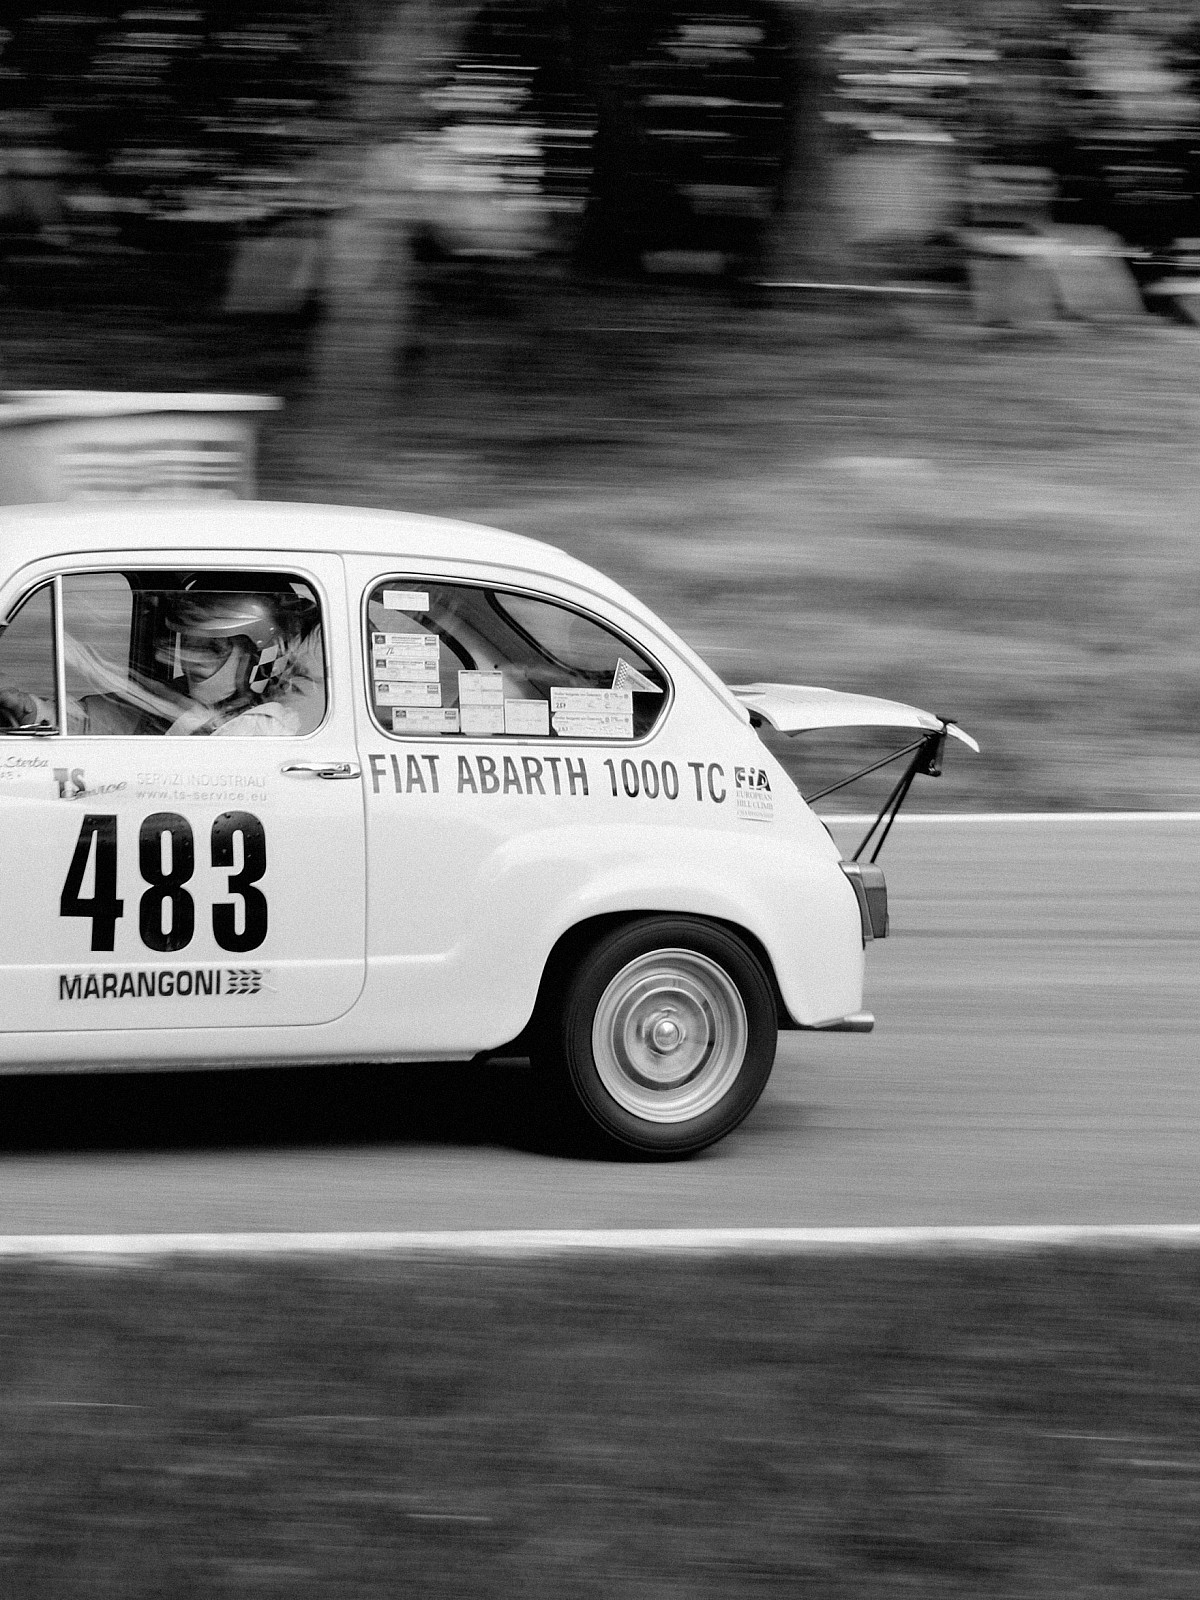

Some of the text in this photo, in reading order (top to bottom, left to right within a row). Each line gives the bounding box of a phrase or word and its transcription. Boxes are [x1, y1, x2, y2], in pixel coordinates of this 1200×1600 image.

[52, 767, 86, 799] TS
[368, 754, 727, 804] FIAT ABARTH 1000 TC
[134, 789, 268, 802] www.ts-service.eu
[736, 790, 773, 801] EUROPEAN
[736, 799, 774, 811] HILL CLIMB
[60, 810, 268, 953] 483
[59, 969, 221, 1001] MARANGONI
